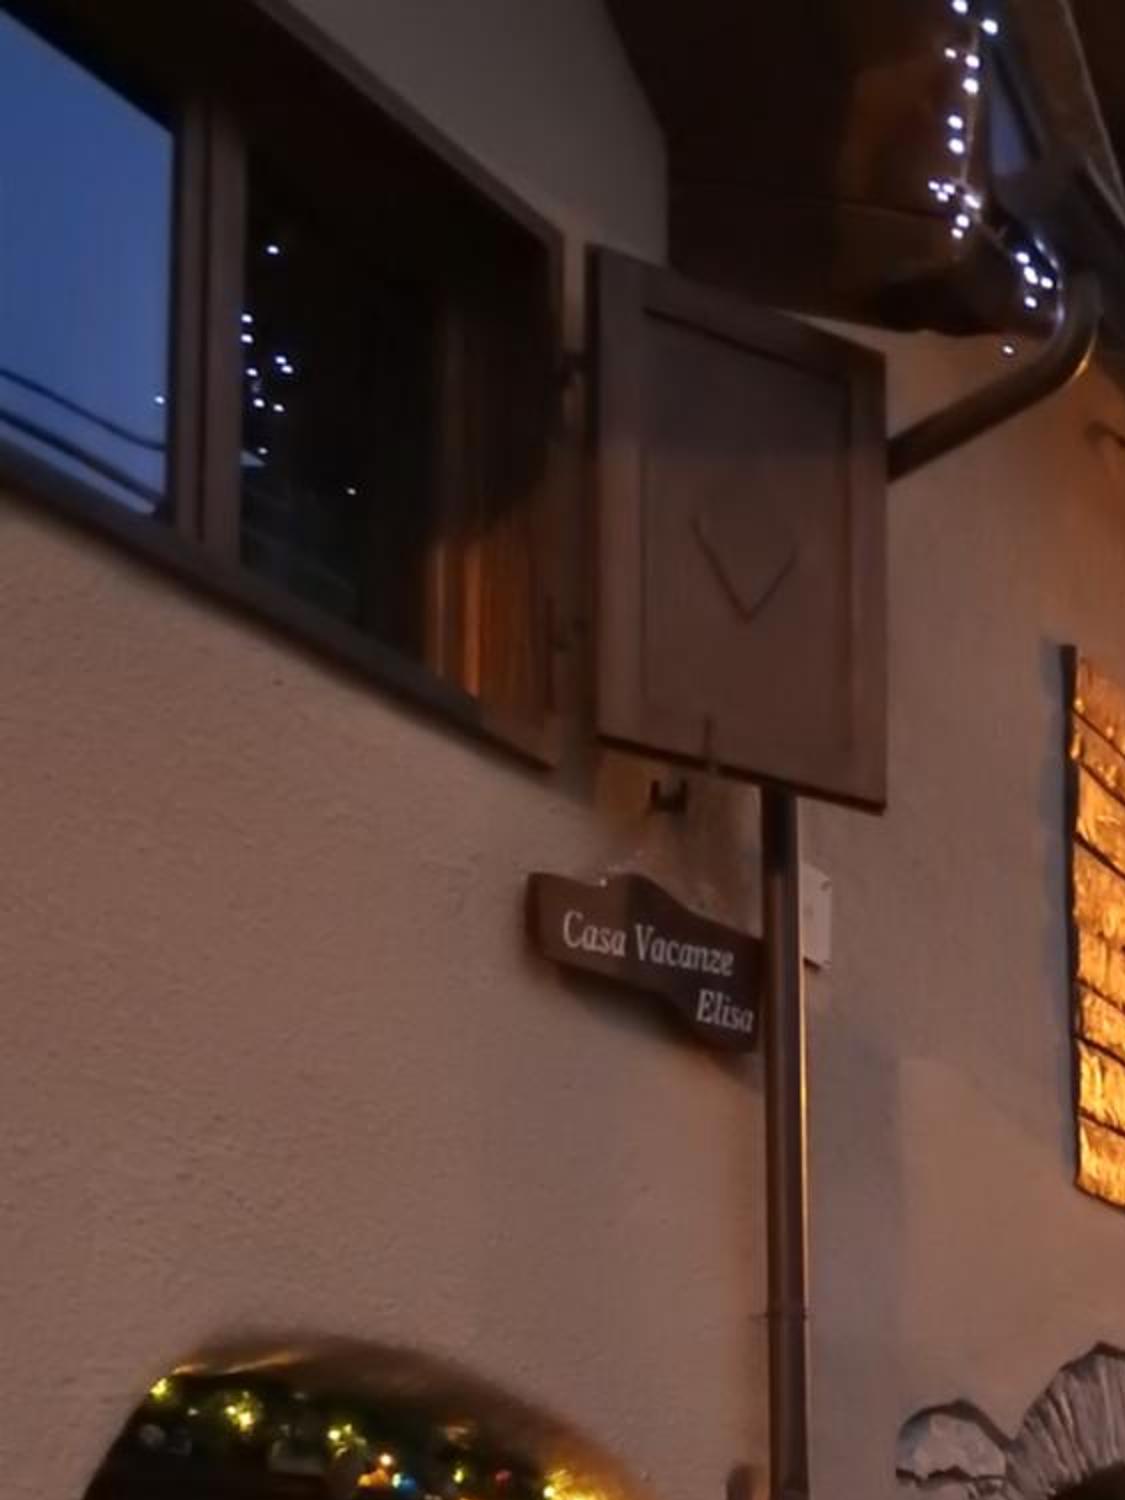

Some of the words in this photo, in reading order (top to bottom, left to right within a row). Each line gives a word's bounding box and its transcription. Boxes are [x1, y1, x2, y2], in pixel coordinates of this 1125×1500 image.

[562, 909, 627, 957] Casa
[634, 922, 735, 977] Vacanze
[695, 988, 755, 1033] Elisa
